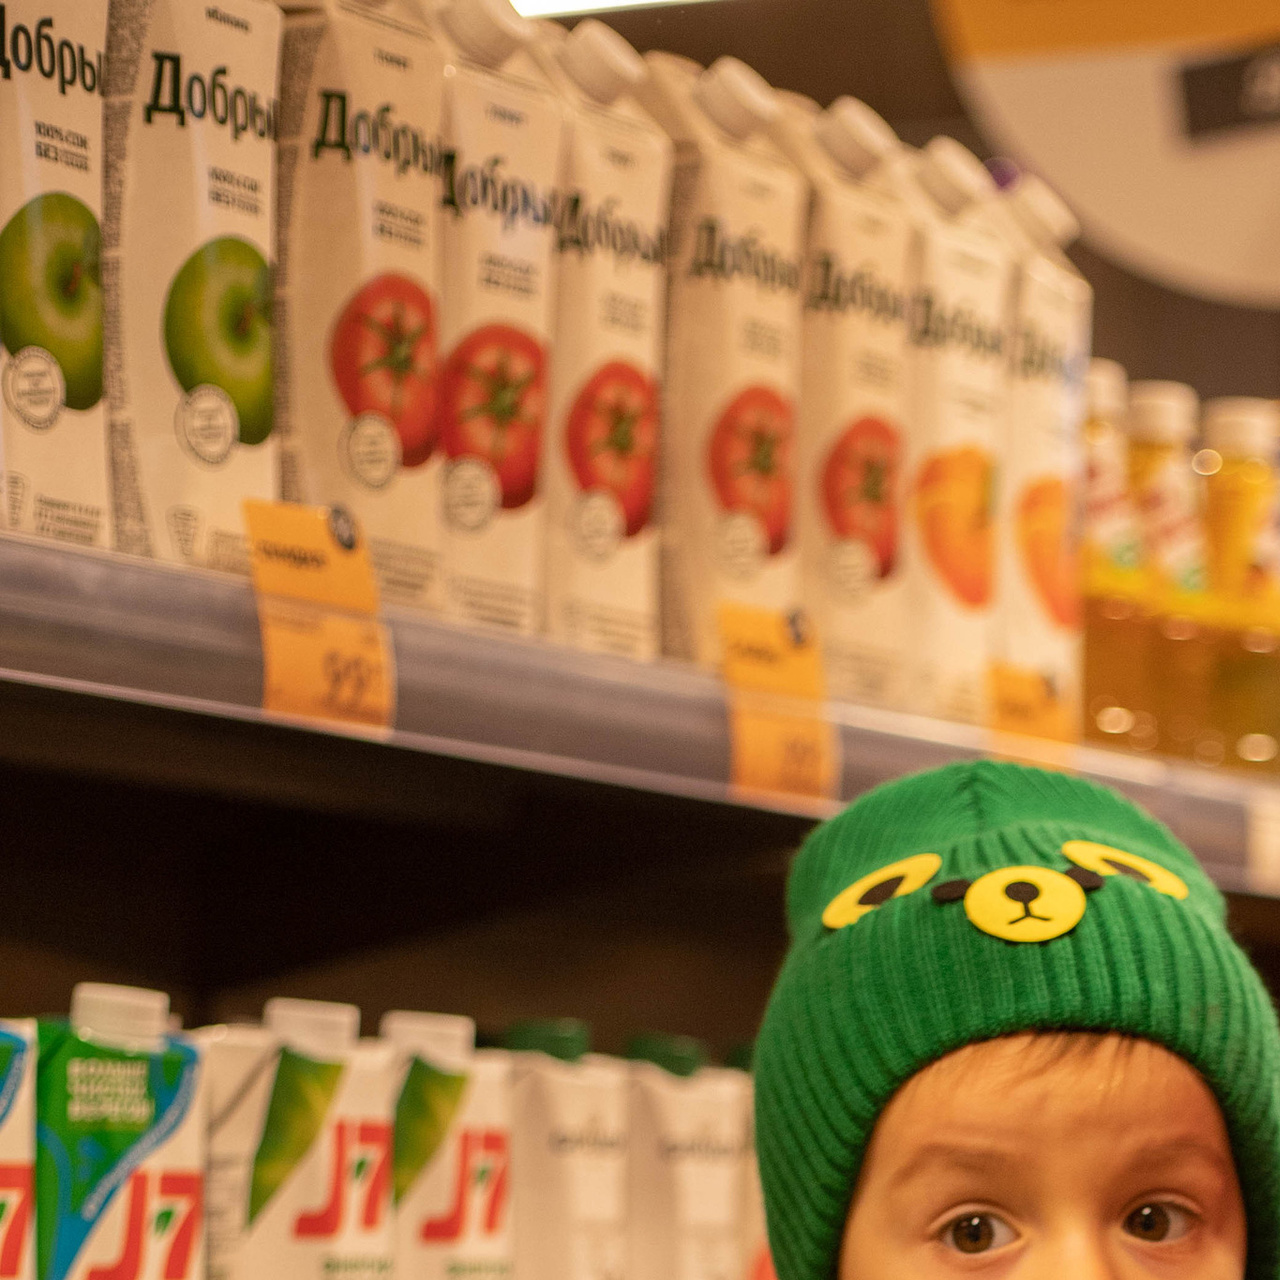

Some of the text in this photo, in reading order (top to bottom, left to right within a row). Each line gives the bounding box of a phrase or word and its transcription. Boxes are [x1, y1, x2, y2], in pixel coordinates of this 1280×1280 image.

[0, 3, 103, 95] обры
[0, 1163, 36, 1278] 7
[293, 1120, 396, 1239] J7
[420, 1126, 509, 1241] J7
